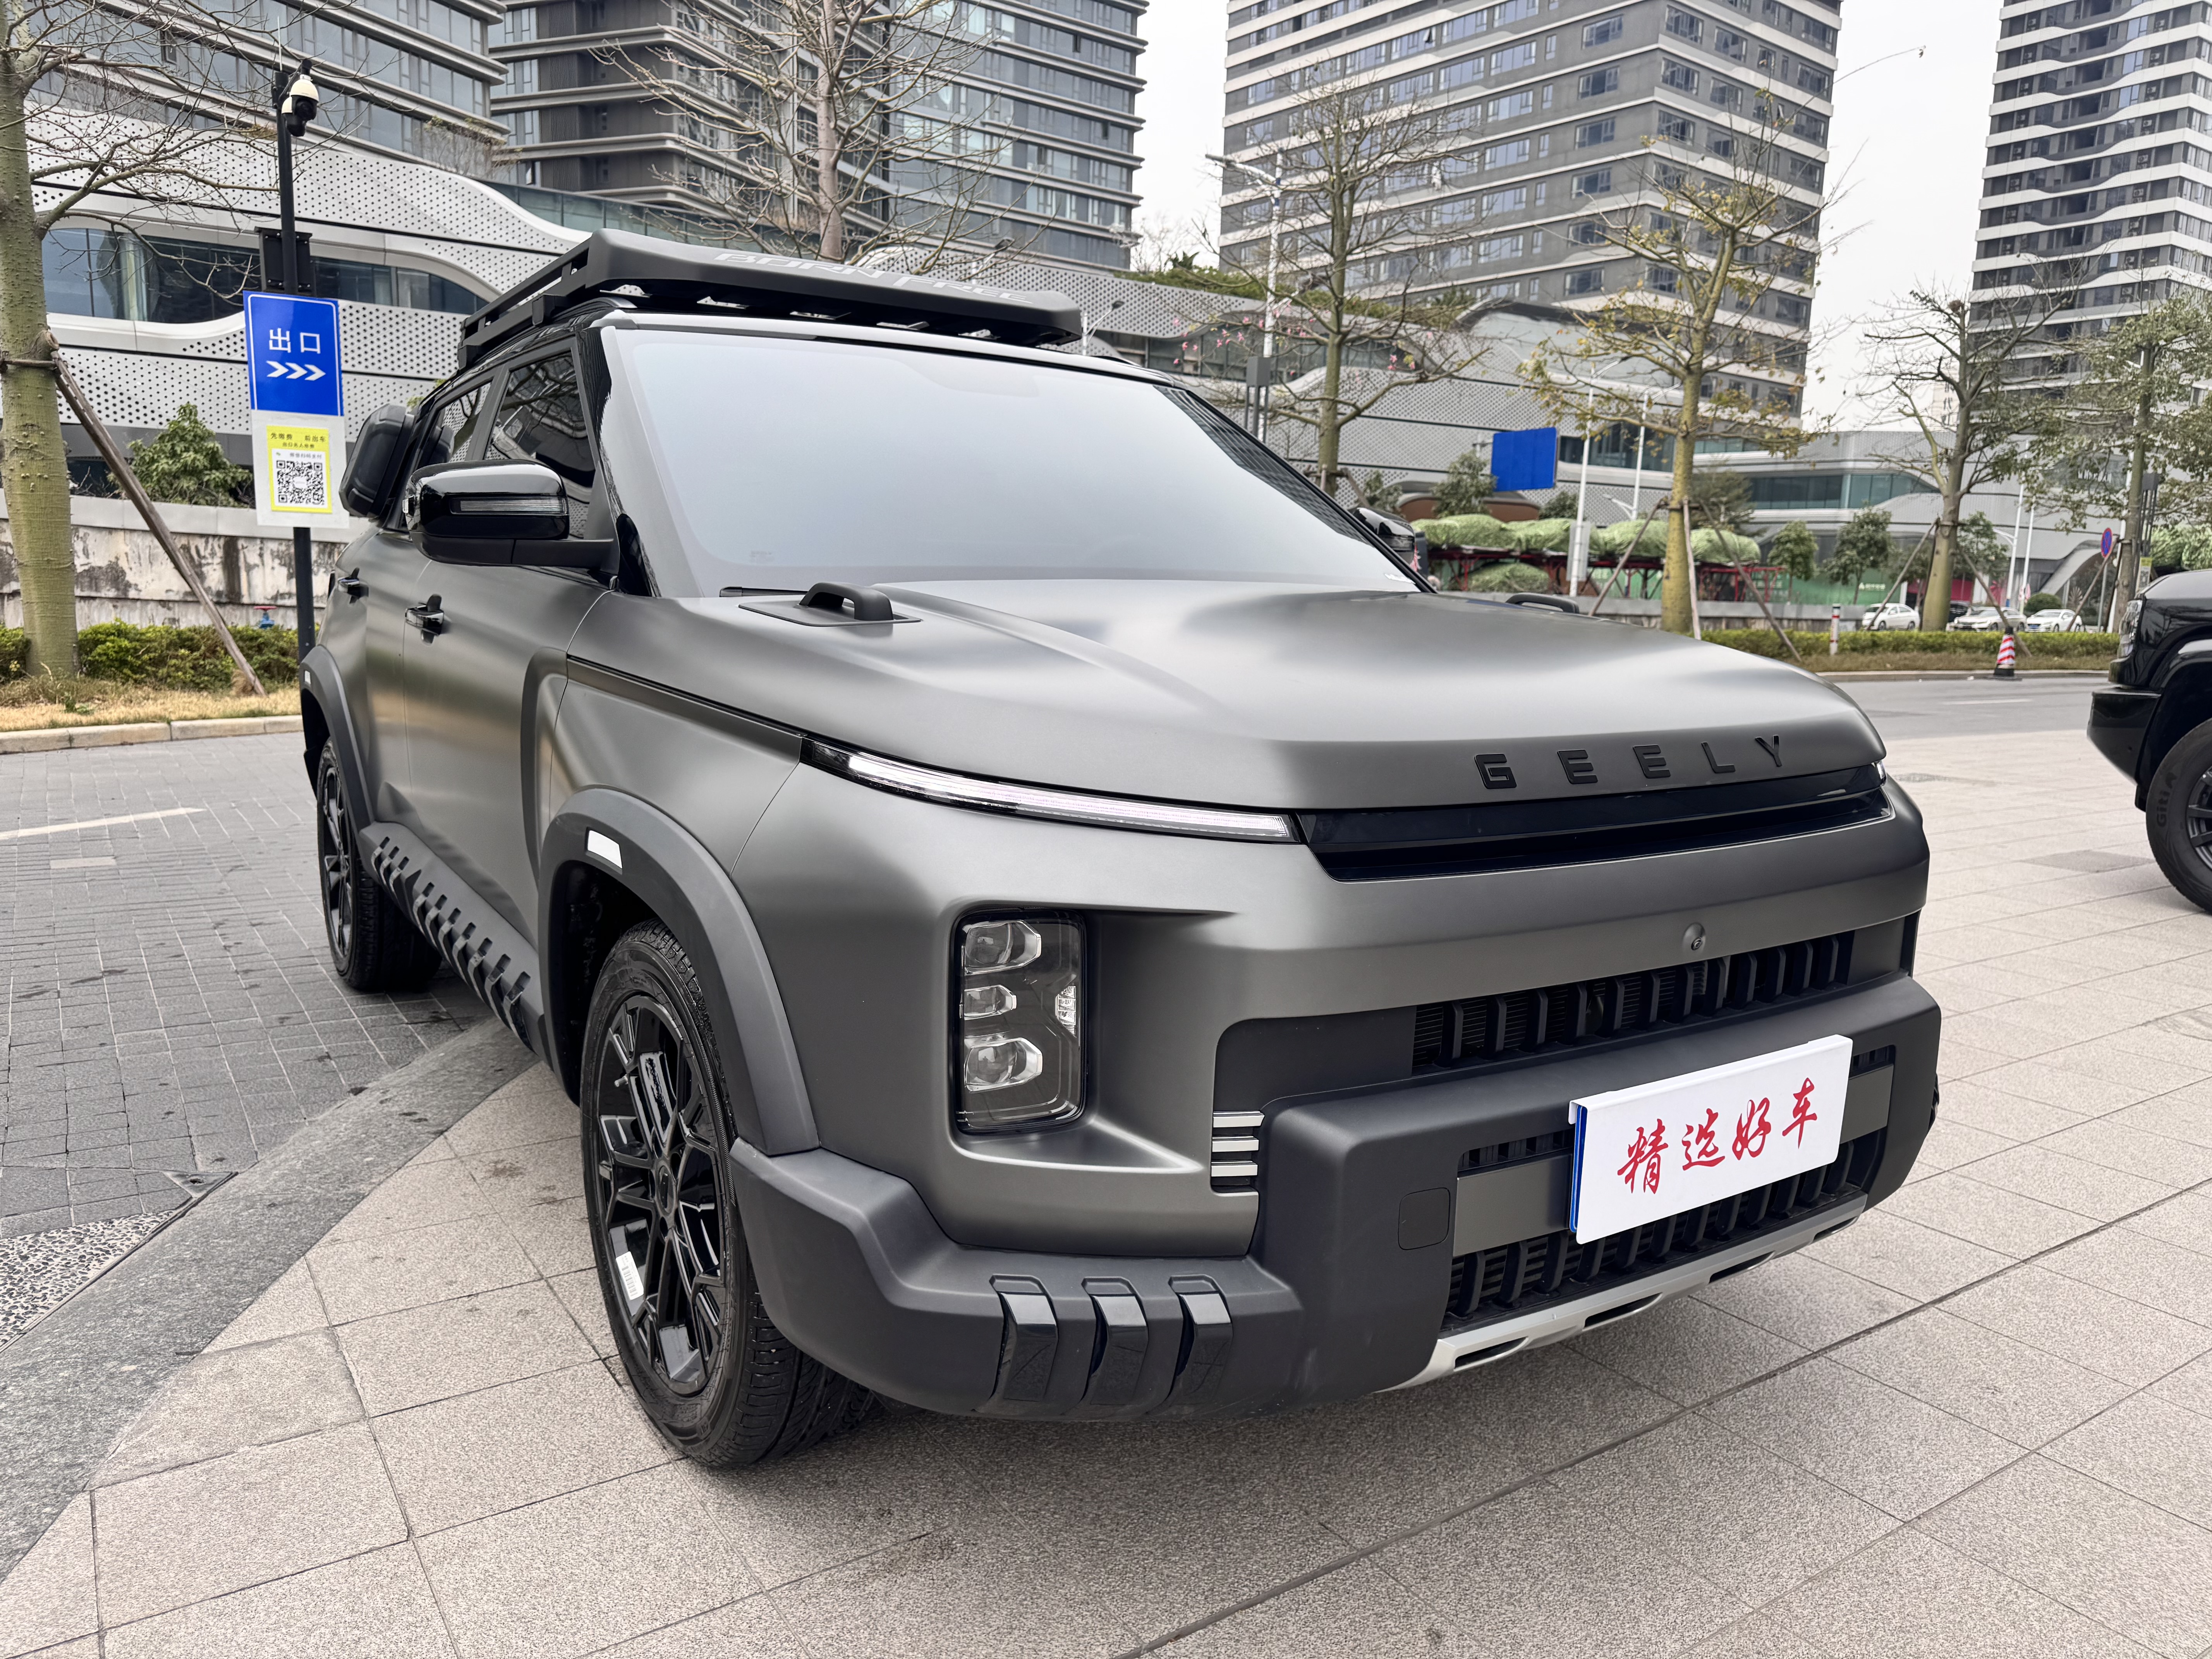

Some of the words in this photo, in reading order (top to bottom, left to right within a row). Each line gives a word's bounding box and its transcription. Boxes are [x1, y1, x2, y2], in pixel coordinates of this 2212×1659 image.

[714, 253, 885, 278] BORN
[892, 276, 1033, 304] FREE
[269, 328, 321, 354] 出口
[1474, 734, 1782, 790] GEELY
[2157, 790, 2169, 827] Giti
[1617, 1077, 1817, 1194] 精选好车
